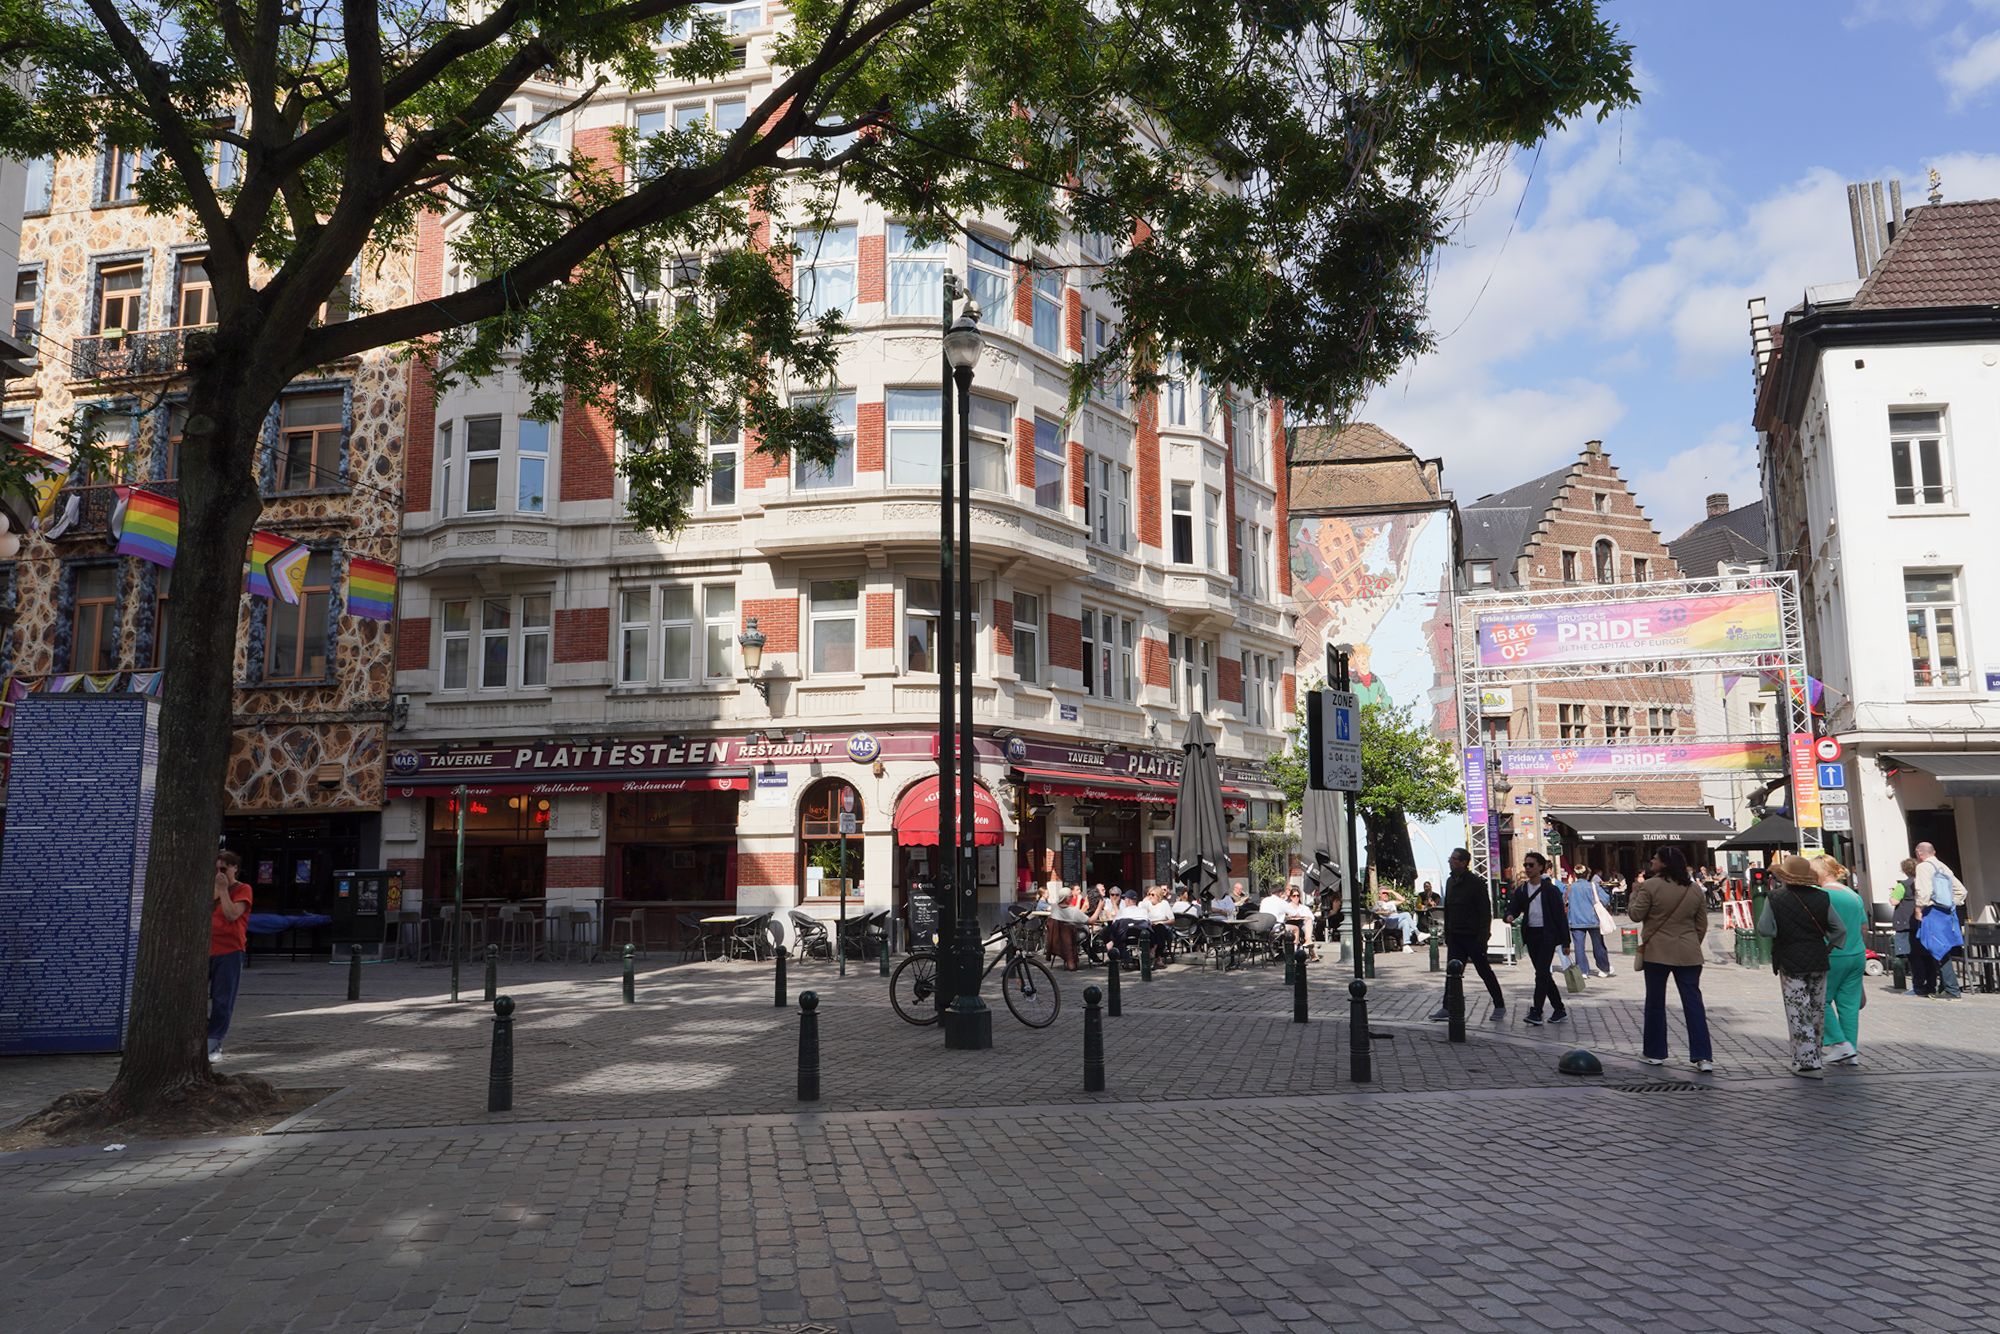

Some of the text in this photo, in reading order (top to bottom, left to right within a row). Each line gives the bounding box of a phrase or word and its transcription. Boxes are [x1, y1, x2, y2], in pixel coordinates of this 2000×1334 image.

[1511, 613, 1543, 622] Saturday
[1557, 612, 1606, 623] BRUSSELS
[1658, 607, 1687, 622] 30
[1490, 623, 1538, 644] 15&16
[1557, 617, 1652, 643] PRIDE
[1501, 642, 1529, 660] 05
[1559, 637, 1689, 653] IN THE CAPITAL OF EUROPE
[1332, 693, 1353, 708] ZONE
[849, 741, 876, 752] MAES
[395, 741, 834, 769] MAES TAVERNE PLATTESTEEN RESTAURANT
[1068, 752, 1105, 765] TAVERNE
[1508, 753, 1536, 763] Friday
[1551, 751, 1579, 762] 15&16
[1611, 752, 1667, 766] PRIDE
[1508, 762, 1550, 770] Saturday
[1558, 762, 1574, 772] 05
[450, 780, 687, 795] Tverne Plattesteen Restaurant
